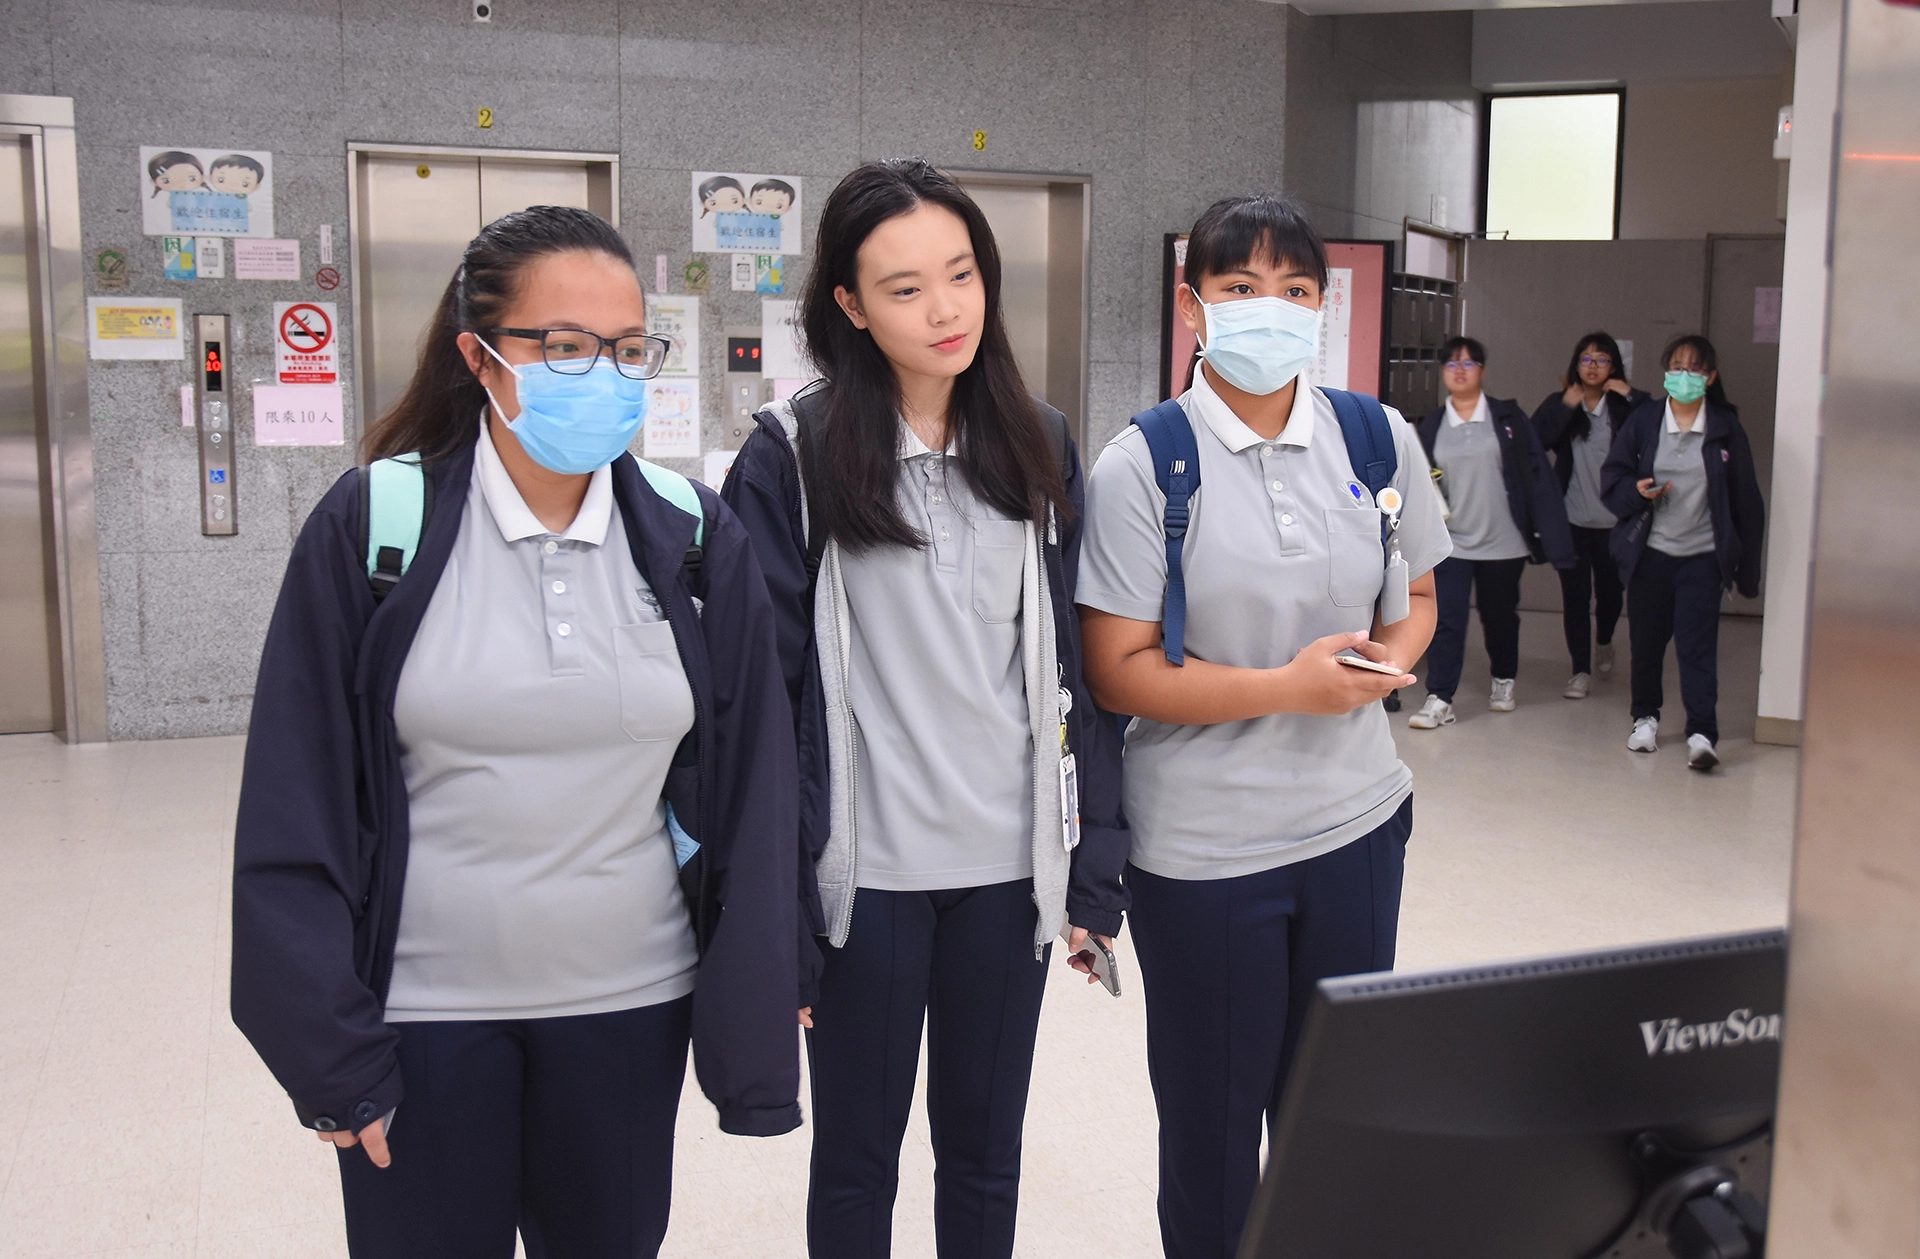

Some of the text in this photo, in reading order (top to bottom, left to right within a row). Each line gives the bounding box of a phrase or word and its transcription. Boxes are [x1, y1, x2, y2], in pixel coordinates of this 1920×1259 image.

[480, 109, 491, 128] 2
[975, 131, 985, 150] 3
[177, 206, 245, 219] 歡迎住宿生
[721, 225, 777, 238] 歡迎住宿生
[1331, 277, 1344, 320] 注意!
[206, 359, 222, 371] 10
